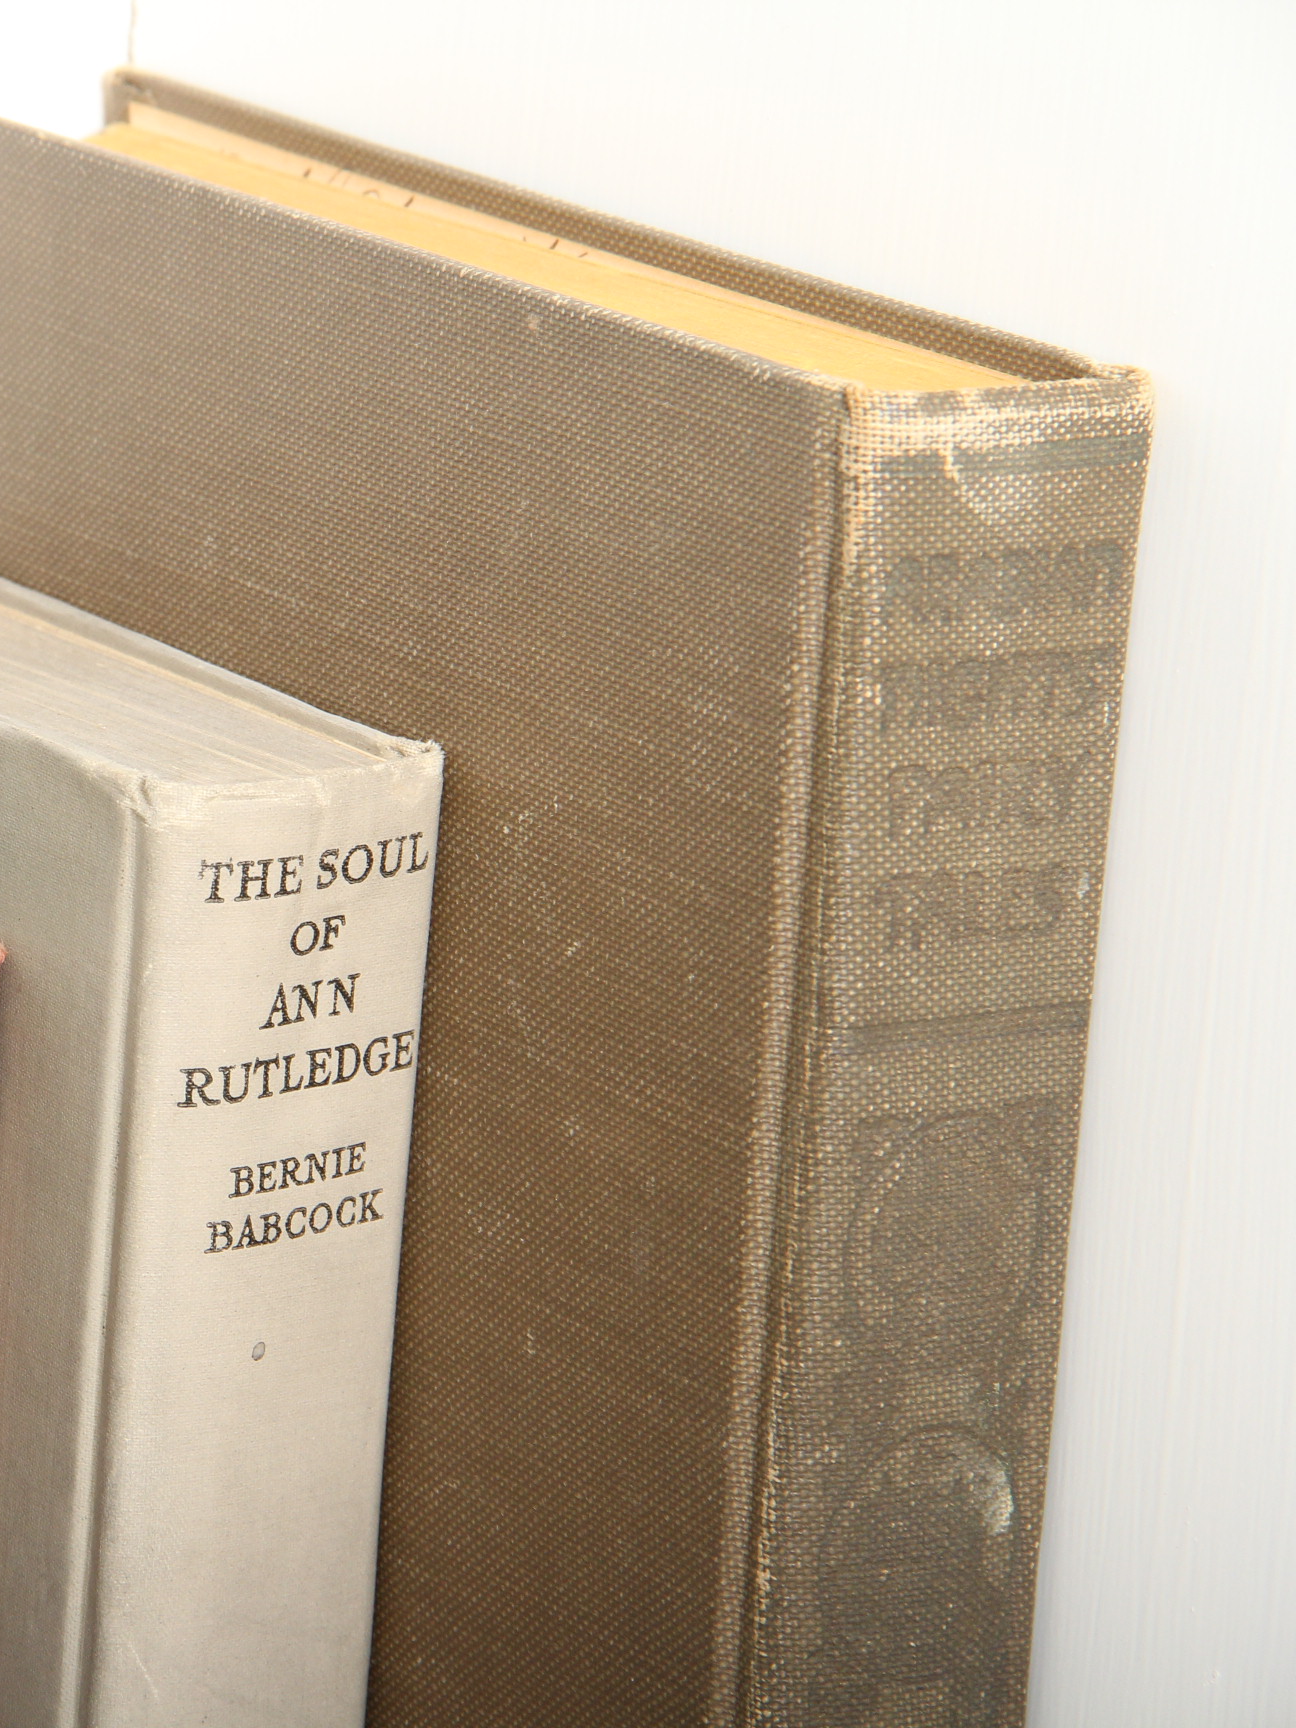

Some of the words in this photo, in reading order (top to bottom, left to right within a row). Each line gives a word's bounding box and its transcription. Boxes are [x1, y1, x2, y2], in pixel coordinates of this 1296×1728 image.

[199, 854, 304, 903] THE
[315, 831, 429, 890] SOUL
[289, 915, 346, 956] OF
[258, 973, 361, 1030] ANN
[176, 1029, 415, 1108] RUTLEDGE
[228, 1141, 366, 1199] BERNIE
[204, 1189, 383, 1254] BABCOCK
